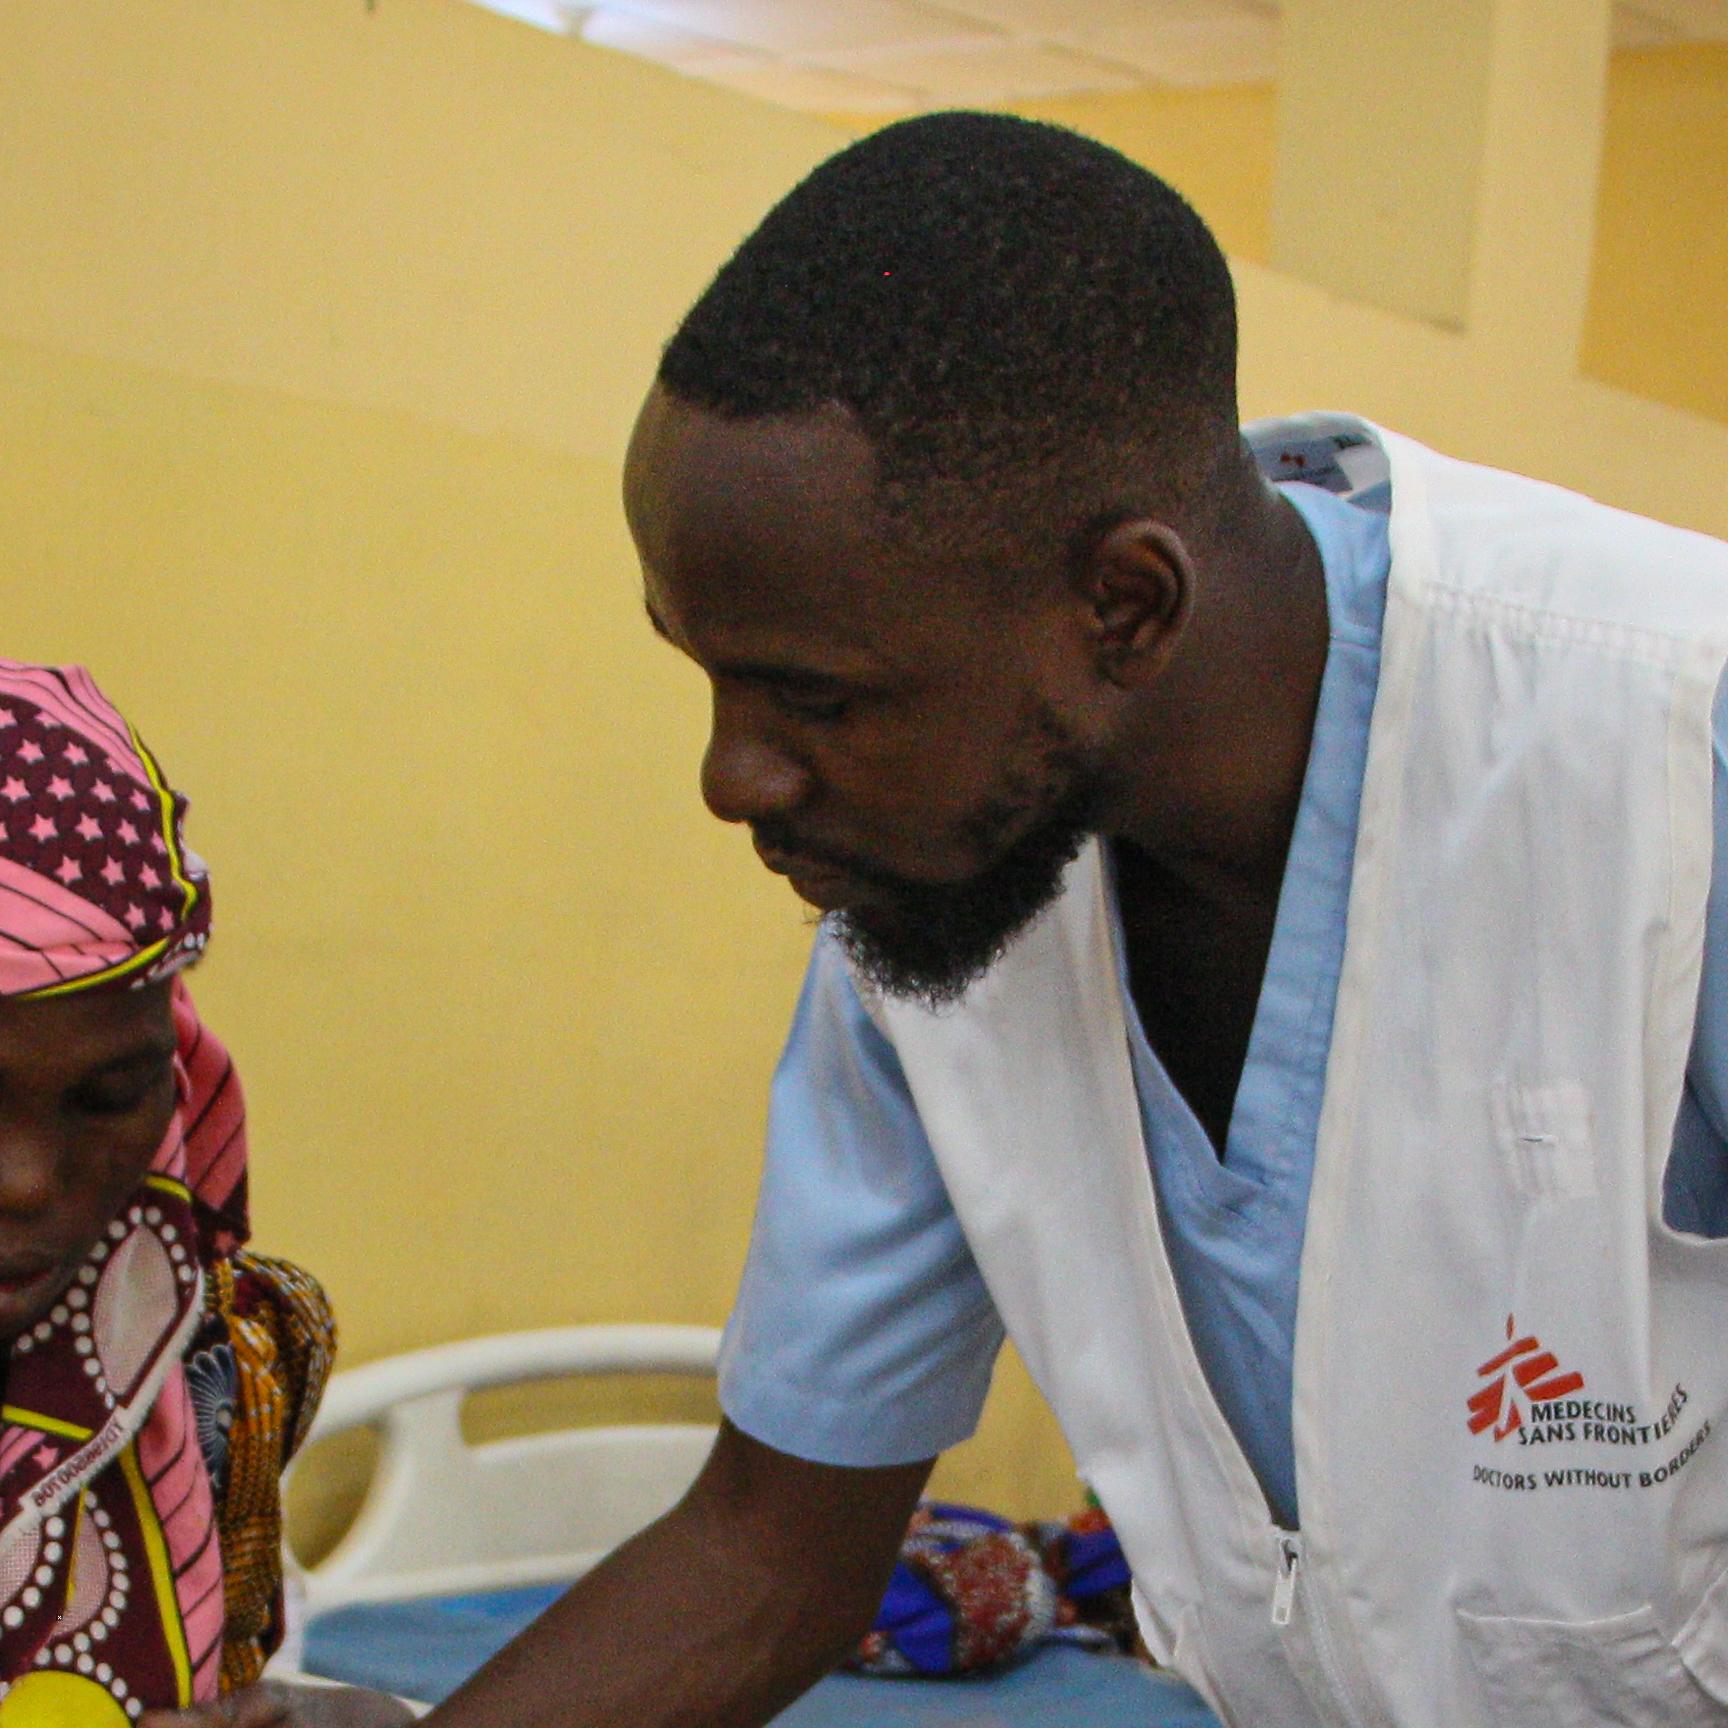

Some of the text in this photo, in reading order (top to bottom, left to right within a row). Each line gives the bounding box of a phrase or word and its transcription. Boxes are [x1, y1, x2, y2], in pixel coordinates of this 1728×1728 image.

[1518, 1383, 1688, 1446] SANS FRONTIERES
[1530, 1401, 1637, 1424] MEDECINS
[1473, 1420, 1712, 1491] DOCTORS WITHOUT BORDERS
